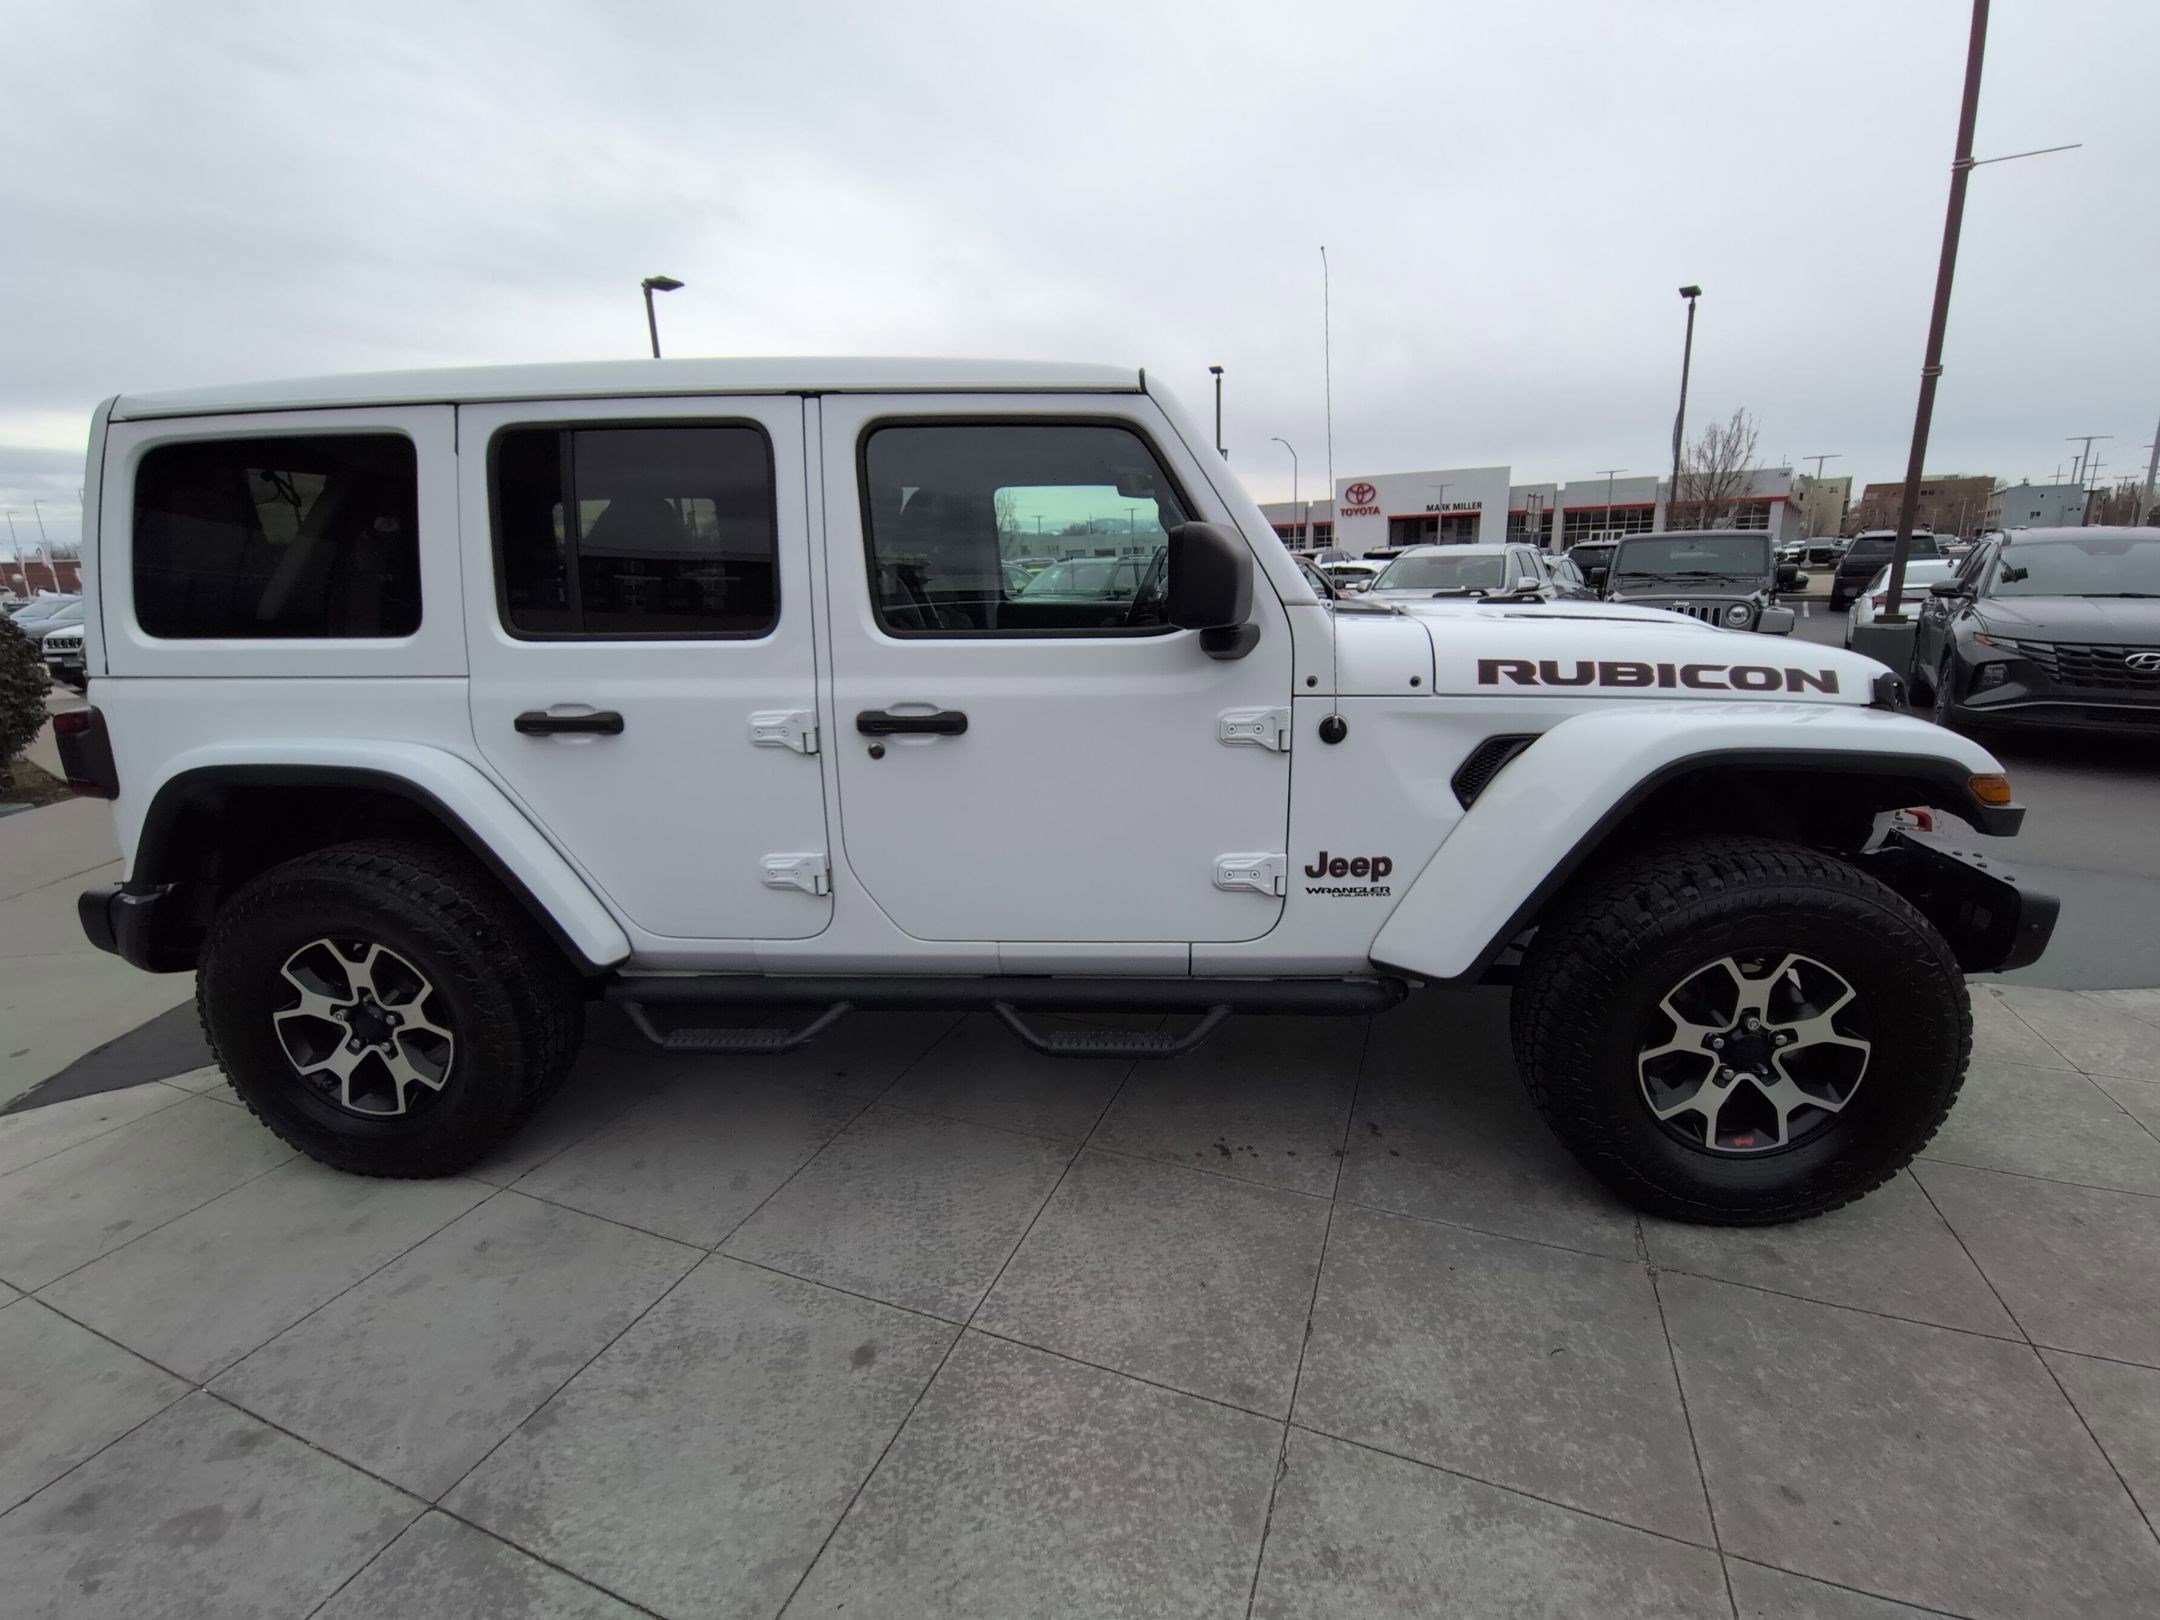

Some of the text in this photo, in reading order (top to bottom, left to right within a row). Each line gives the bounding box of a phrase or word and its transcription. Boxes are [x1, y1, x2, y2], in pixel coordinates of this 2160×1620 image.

[1339, 505, 1381, 517] TOYOTA
[1426, 501, 1482, 512] MARK MILLER
[1477, 658, 1840, 694] RUBICON
[1304, 850, 1393, 882] Jeep
[1305, 886, 1391, 894] WRANGLER
